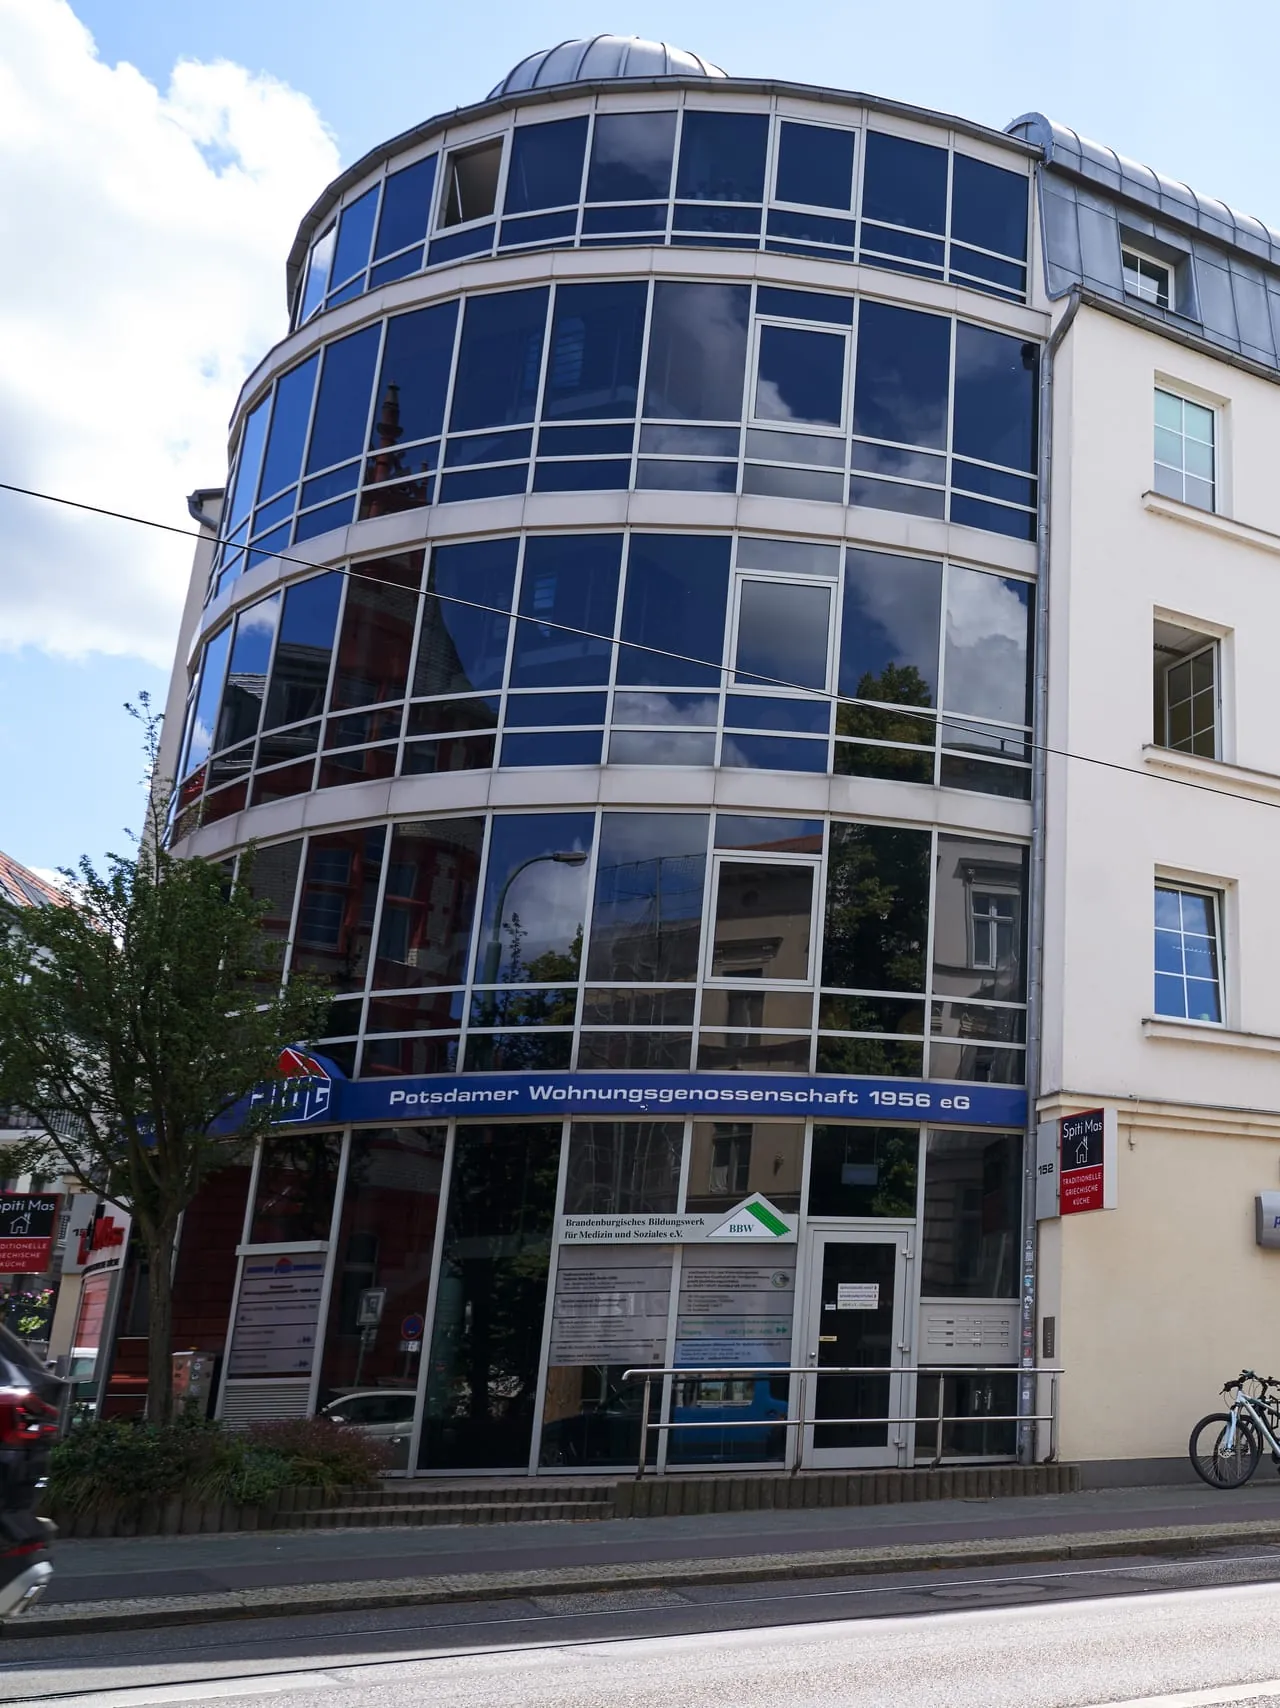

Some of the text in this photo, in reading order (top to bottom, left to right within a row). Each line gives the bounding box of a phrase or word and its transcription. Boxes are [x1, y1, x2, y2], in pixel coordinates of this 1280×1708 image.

[389, 1085, 970, 1110] Potsdamer Wohnungsgenossenschaft 1956 eG
[1063, 1119, 1103, 1140] Spiti Mas
[1038, 1163, 1054, 1175] 152
[1063, 1172, 1102, 1184] TRADITIONELLE
[1065, 1184, 1099, 1196] GRIECHISCHE
[0, 1199, 55, 1213] piti Mas
[1072, 1196, 1091, 1205] KÜCHE
[565, 1217, 705, 1228] Brandenburgisches Bildungswerk
[729, 1224, 754, 1233] BBW
[564, 1229, 683, 1240] für Medizin und Soziales e.V.
